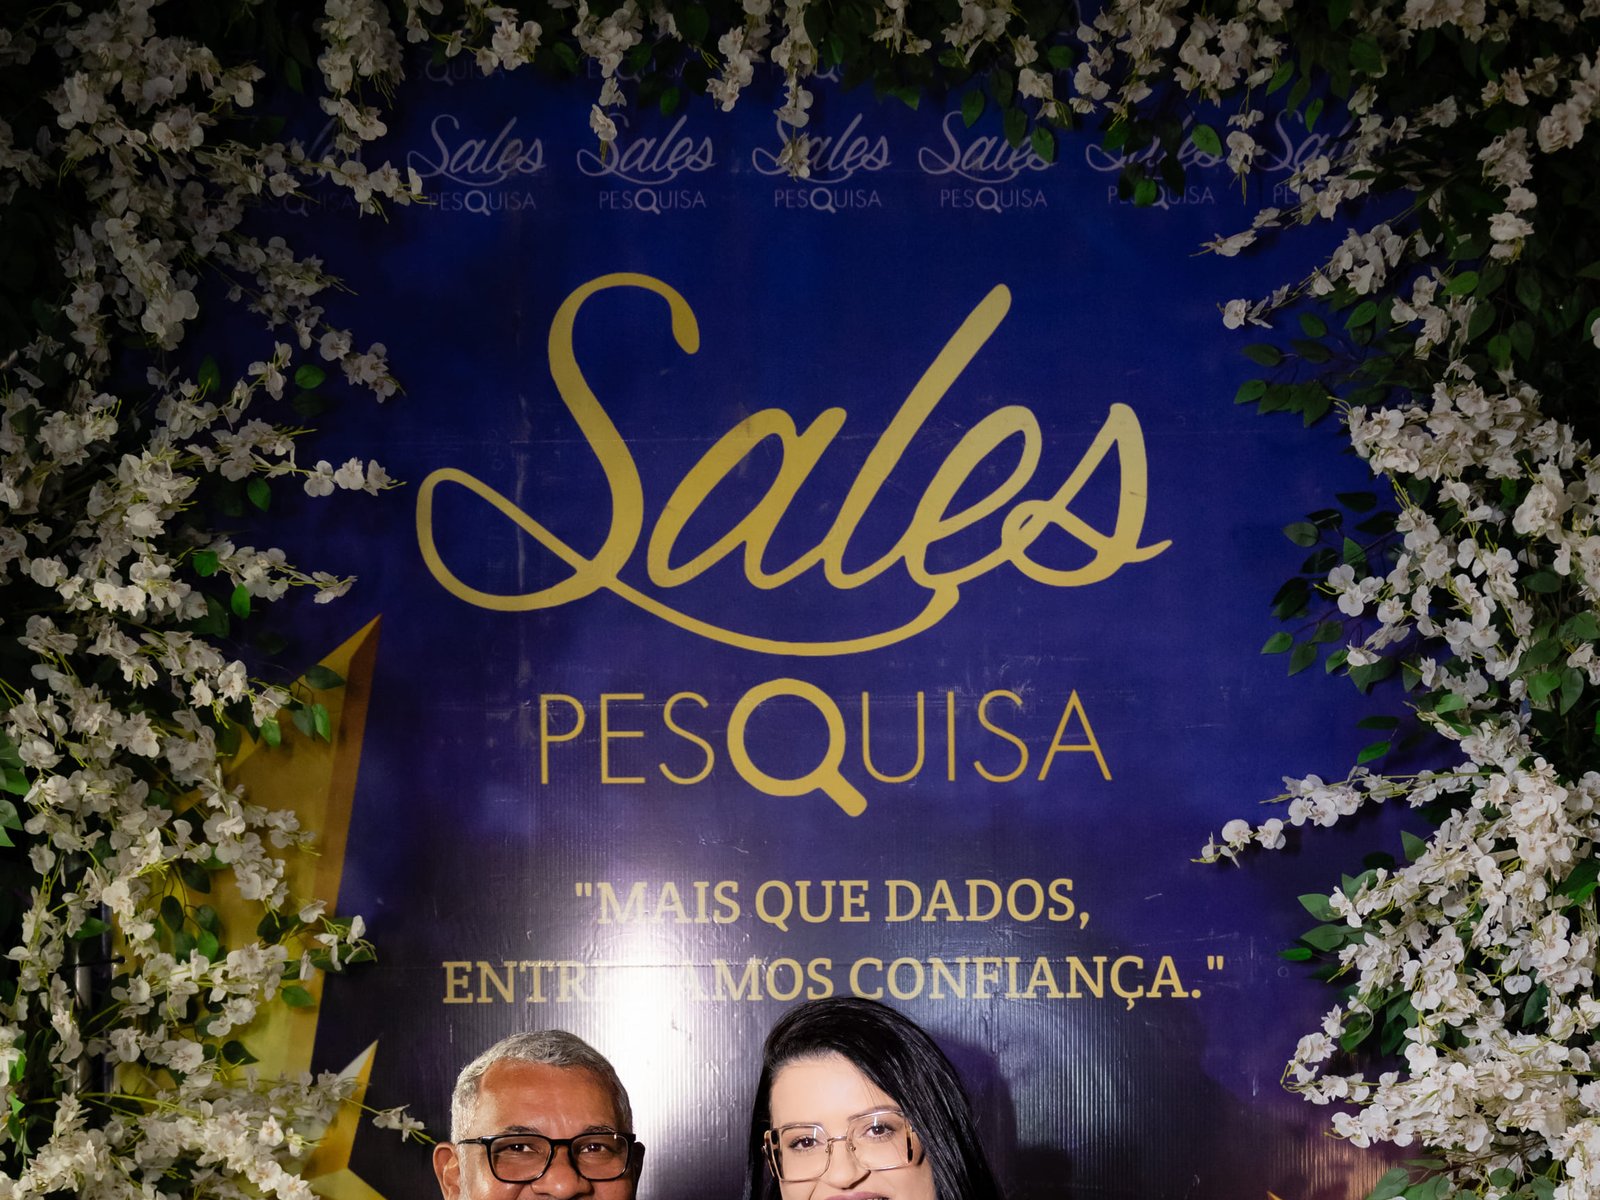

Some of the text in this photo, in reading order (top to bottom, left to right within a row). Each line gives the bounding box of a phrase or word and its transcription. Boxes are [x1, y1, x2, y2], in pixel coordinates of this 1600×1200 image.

[406, 113, 547, 187] Sales
[428, 189, 537, 216] PESQUISA
[599, 188, 707, 215] PESQUISA
[774, 187, 882, 214] PESQUISA
[940, 186, 1048, 214] PESQUISA
[416, 272, 1172, 656] Sales
[539, 678, 1113, 818] PESQUISA
[574, 878, 1091, 933] "MAIS QUE DADOS,
[442, 955, 1225, 1012] ENTRAMOS CONFIANÇA."
